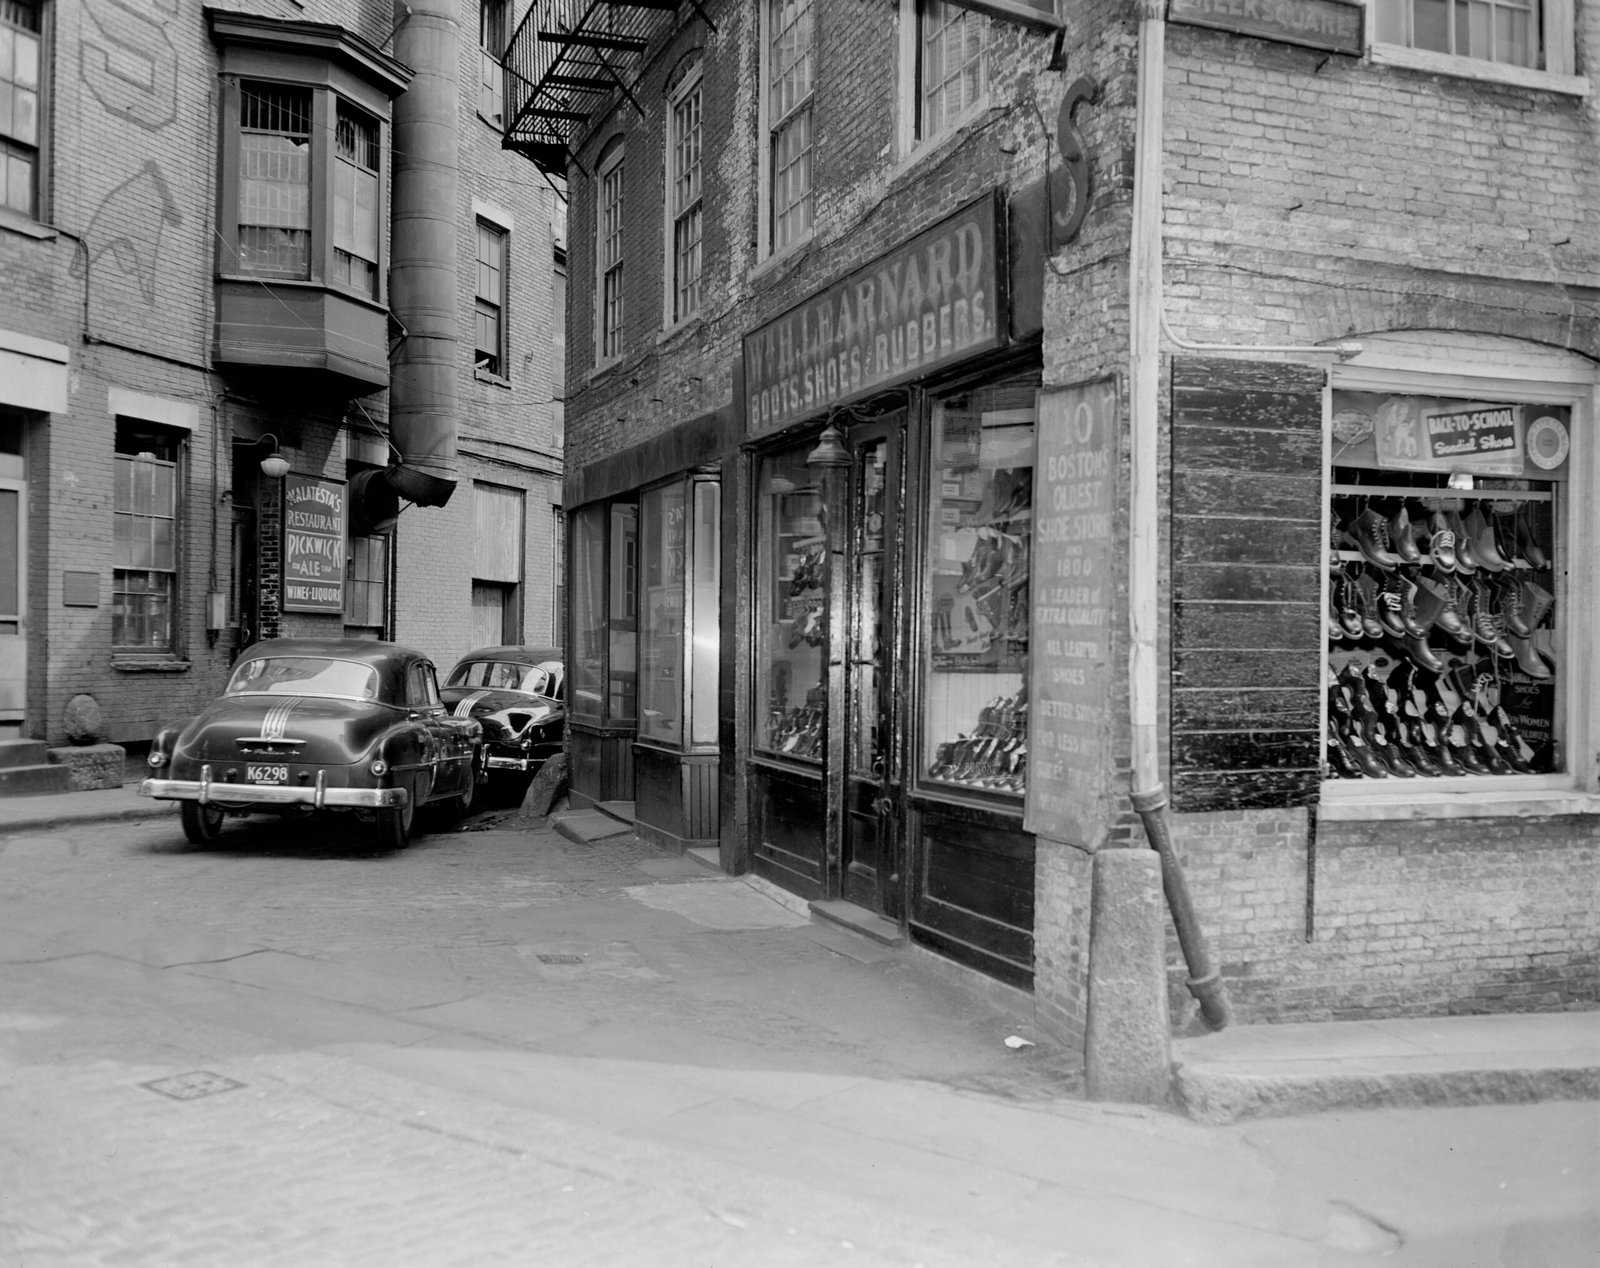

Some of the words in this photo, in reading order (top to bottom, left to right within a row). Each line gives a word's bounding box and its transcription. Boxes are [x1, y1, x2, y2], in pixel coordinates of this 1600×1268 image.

[798, 222, 983, 356] LEARNARD
[804, 345, 860, 403] SHOES
[1428, 409, 1514, 435] BACK-TO-SCHOOL
[286, 485, 342, 513] MALATESTA'S
[1054, 481, 1103, 512] OLDEST
[287, 509, 342, 532] RESTAURANT
[1038, 515, 1070, 543] SHOE
[288, 533, 341, 569] PICKWICK
[299, 560, 321, 577] ALE
[1051, 586, 1088, 604] LEADER
[1036, 606, 1066, 625] EXTRA
[1068, 606, 1106, 627] QUALITY
[1052, 667, 1085, 686] SHOES
[1040, 699, 1073, 721] BETTER
[1519, 714, 1550, 728] WOMEN
[247, 766, 288, 780] K6298
